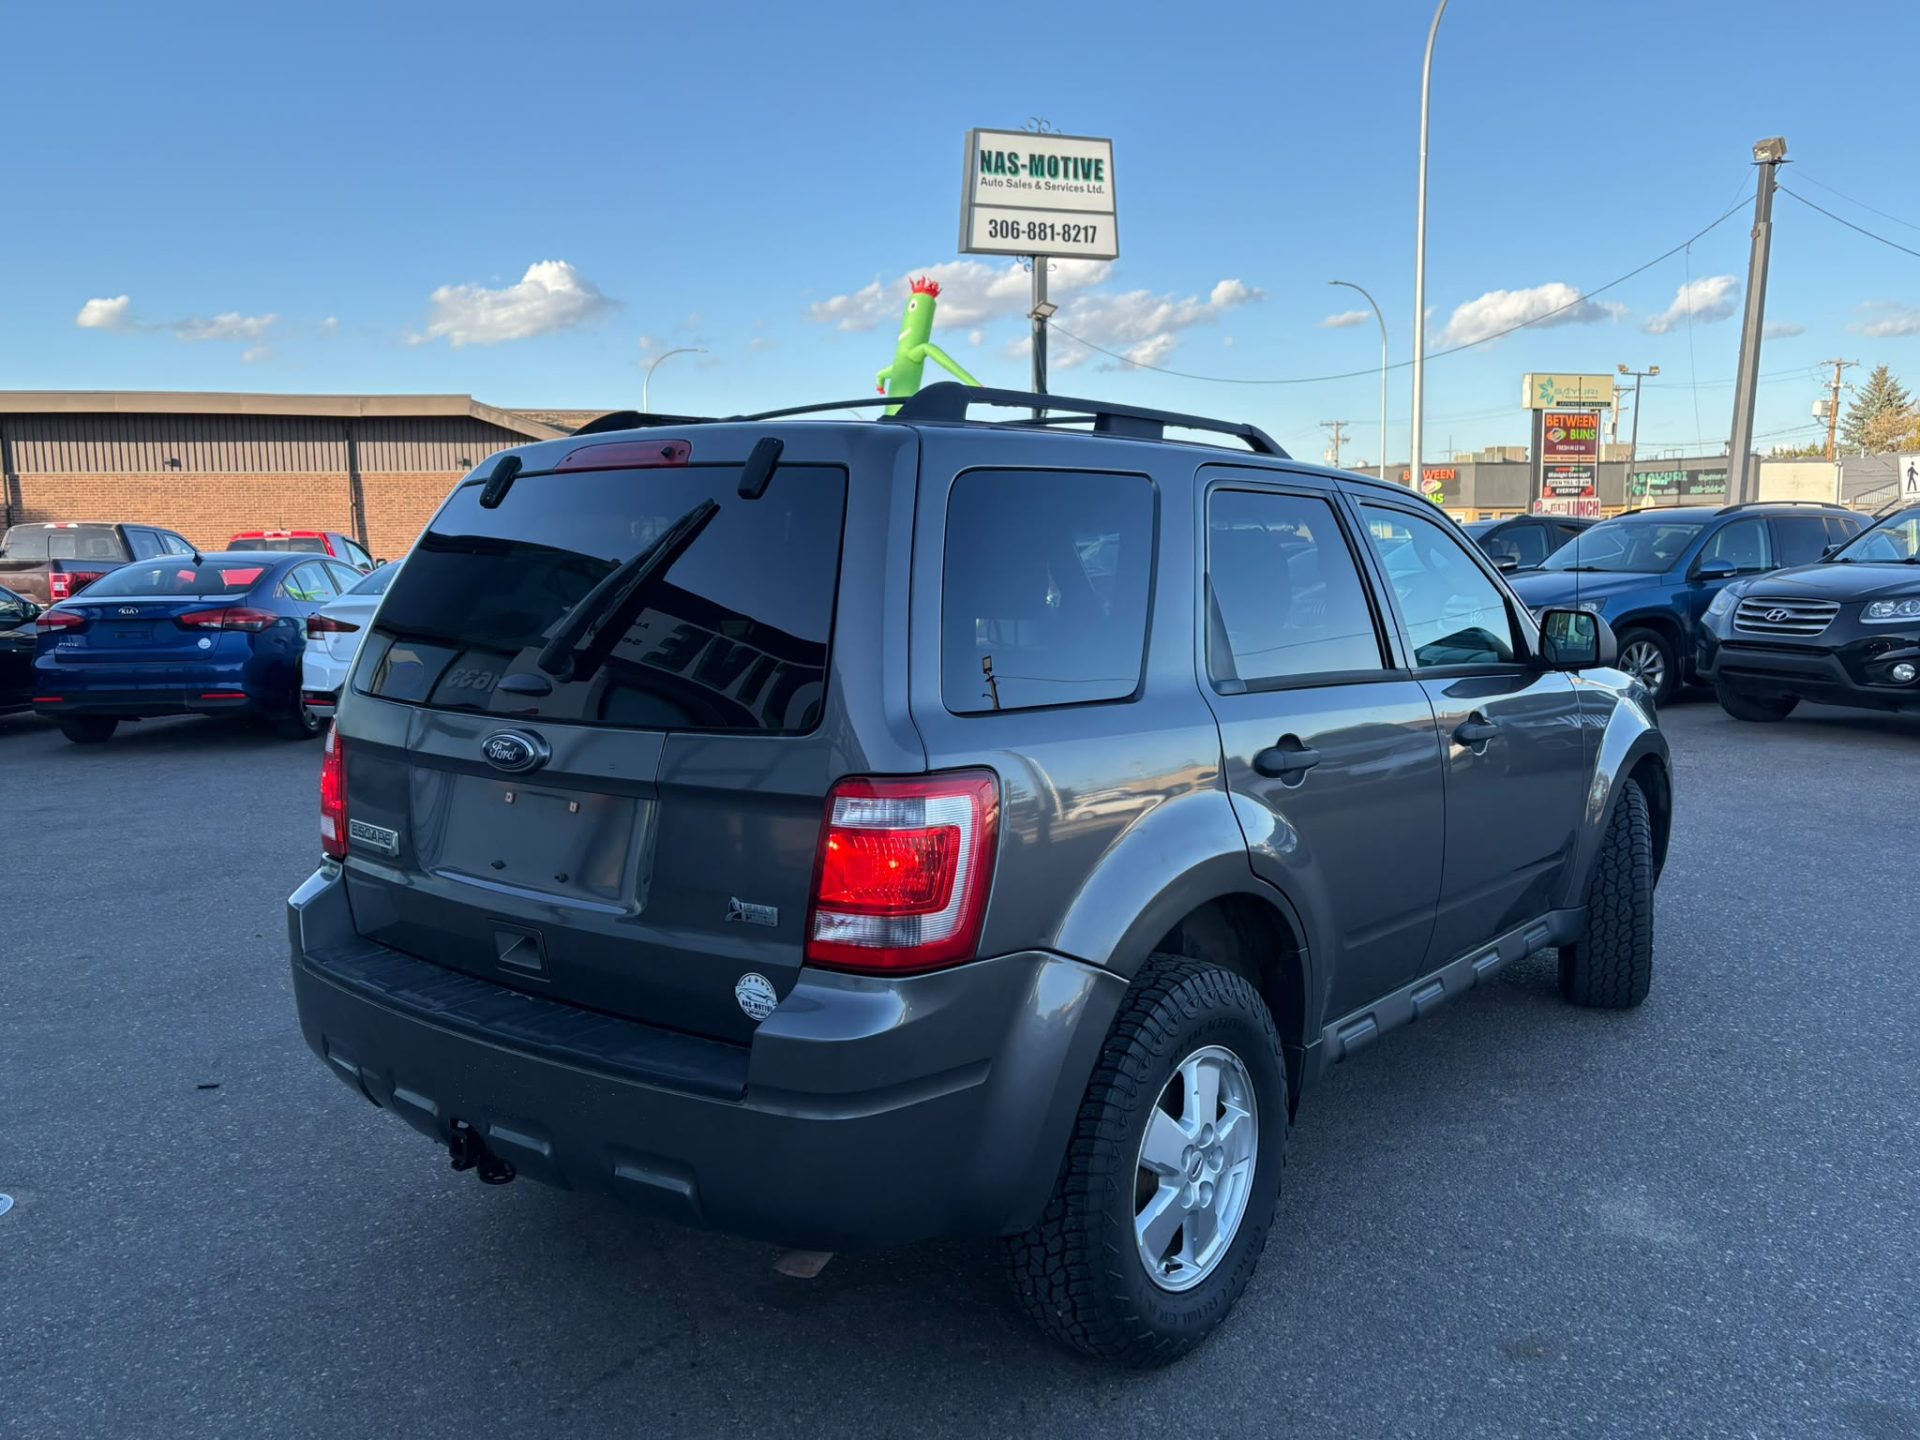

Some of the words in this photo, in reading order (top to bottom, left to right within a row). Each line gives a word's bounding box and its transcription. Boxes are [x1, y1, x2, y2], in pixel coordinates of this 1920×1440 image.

[980, 150, 1105, 182] NAS-MOTIVE
[980, 177, 1004, 187] Auto
[1006, 179, 1032, 189] Sales
[1034, 181, 1042, 190] &
[1044, 181, 1084, 193] Services
[1087, 184, 1105, 194] Ltd.
[988, 219, 1097, 244] 306-881-8217
[1546, 414, 1597, 427] BETWEEN
[1569, 428, 1596, 440] BUNS
[1402, 469, 1456, 481] BWEEN
[1567, 501, 1600, 516] LUNCH
[119, 606, 138, 615] KIA
[489, 740, 516, 761] Ford
[352, 823, 391, 846] ESCAPE
